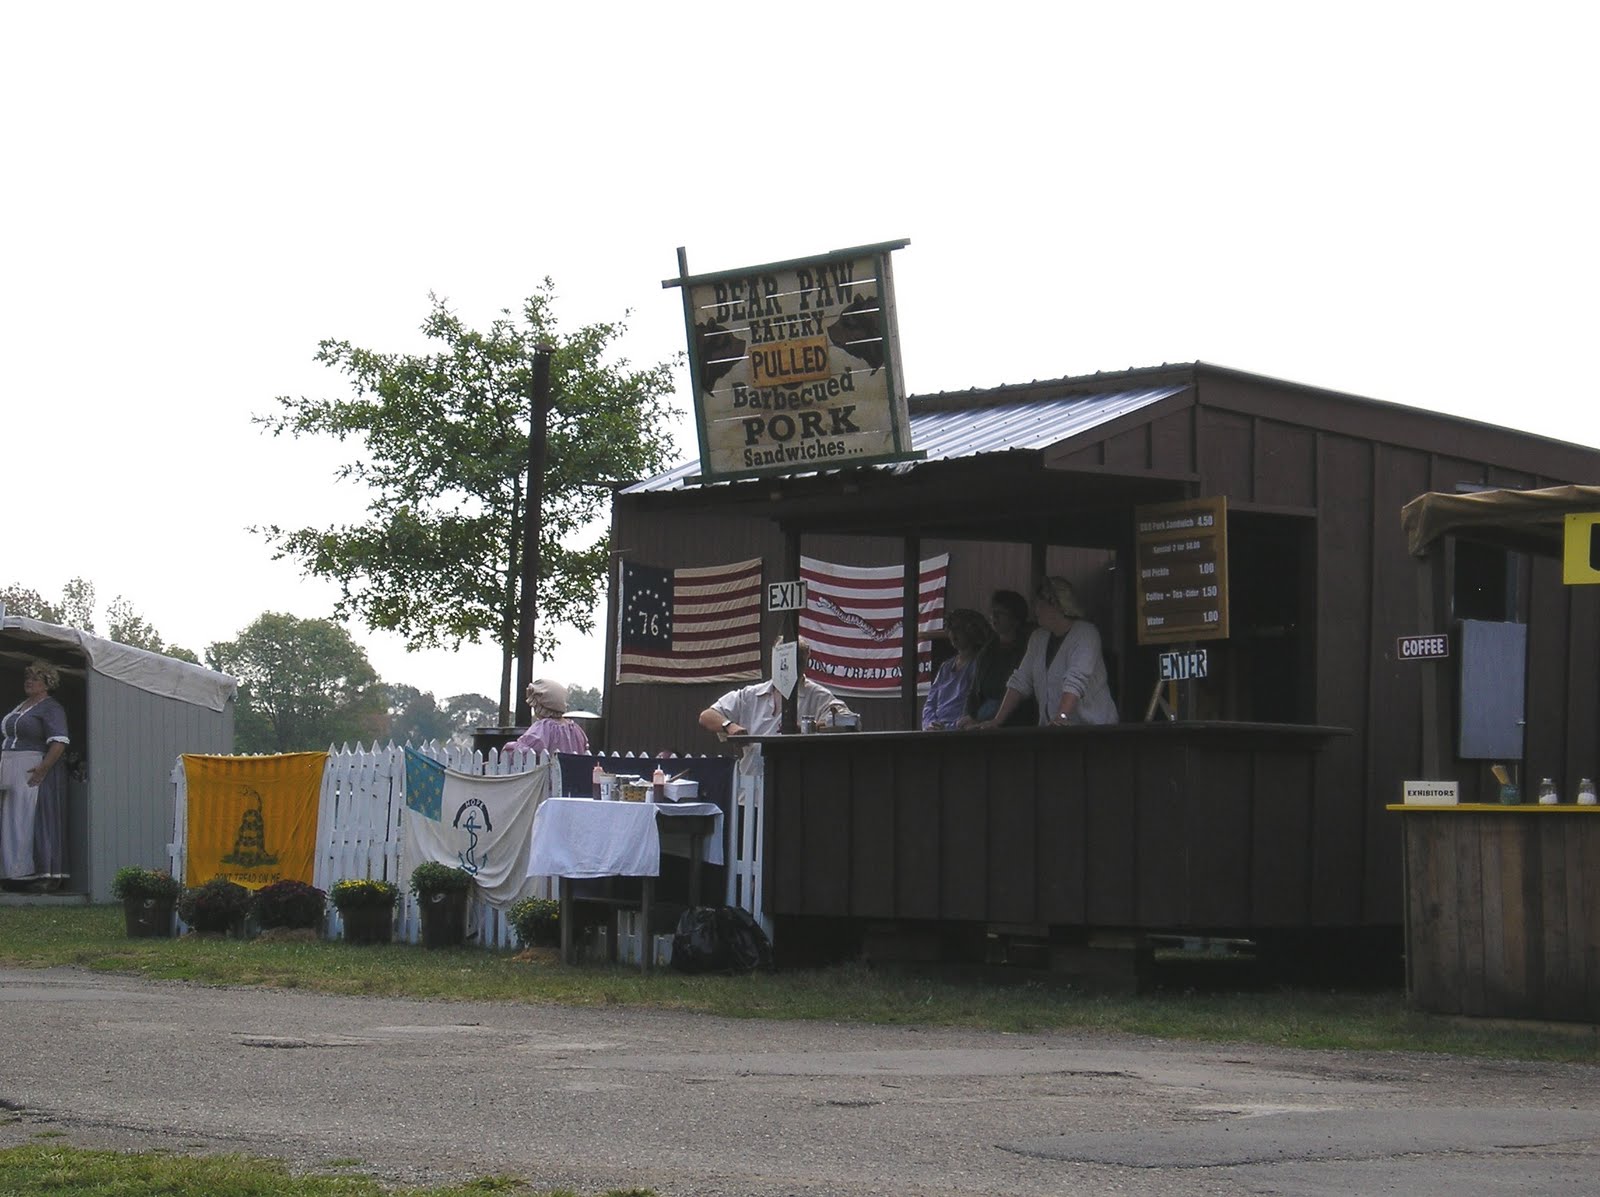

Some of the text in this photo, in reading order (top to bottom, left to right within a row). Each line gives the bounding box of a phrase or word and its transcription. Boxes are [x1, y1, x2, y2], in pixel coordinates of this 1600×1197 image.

[714, 261, 854, 323] BEAR PAW
[750, 310, 825, 344] EATERY
[752, 345, 827, 379] PULLED
[732, 366, 854, 410] Barbecued
[742, 405, 860, 446] PORK
[1197, 515, 1213, 526] 4.50
[1199, 563, 1214, 574] 1.00
[769, 582, 805, 609] EXIT
[1202, 585, 1217, 597] 1.50
[639, 611, 659, 636] 76
[1203, 610, 1218, 622] 1.00
[1402, 638, 1444, 656] COFFEE
[842, 665, 887, 680] TREAD
[1161, 652, 1206, 680] ENTER
[1407, 789, 1455, 797] EXHIBITORS
[258, 872, 270, 883] ON
